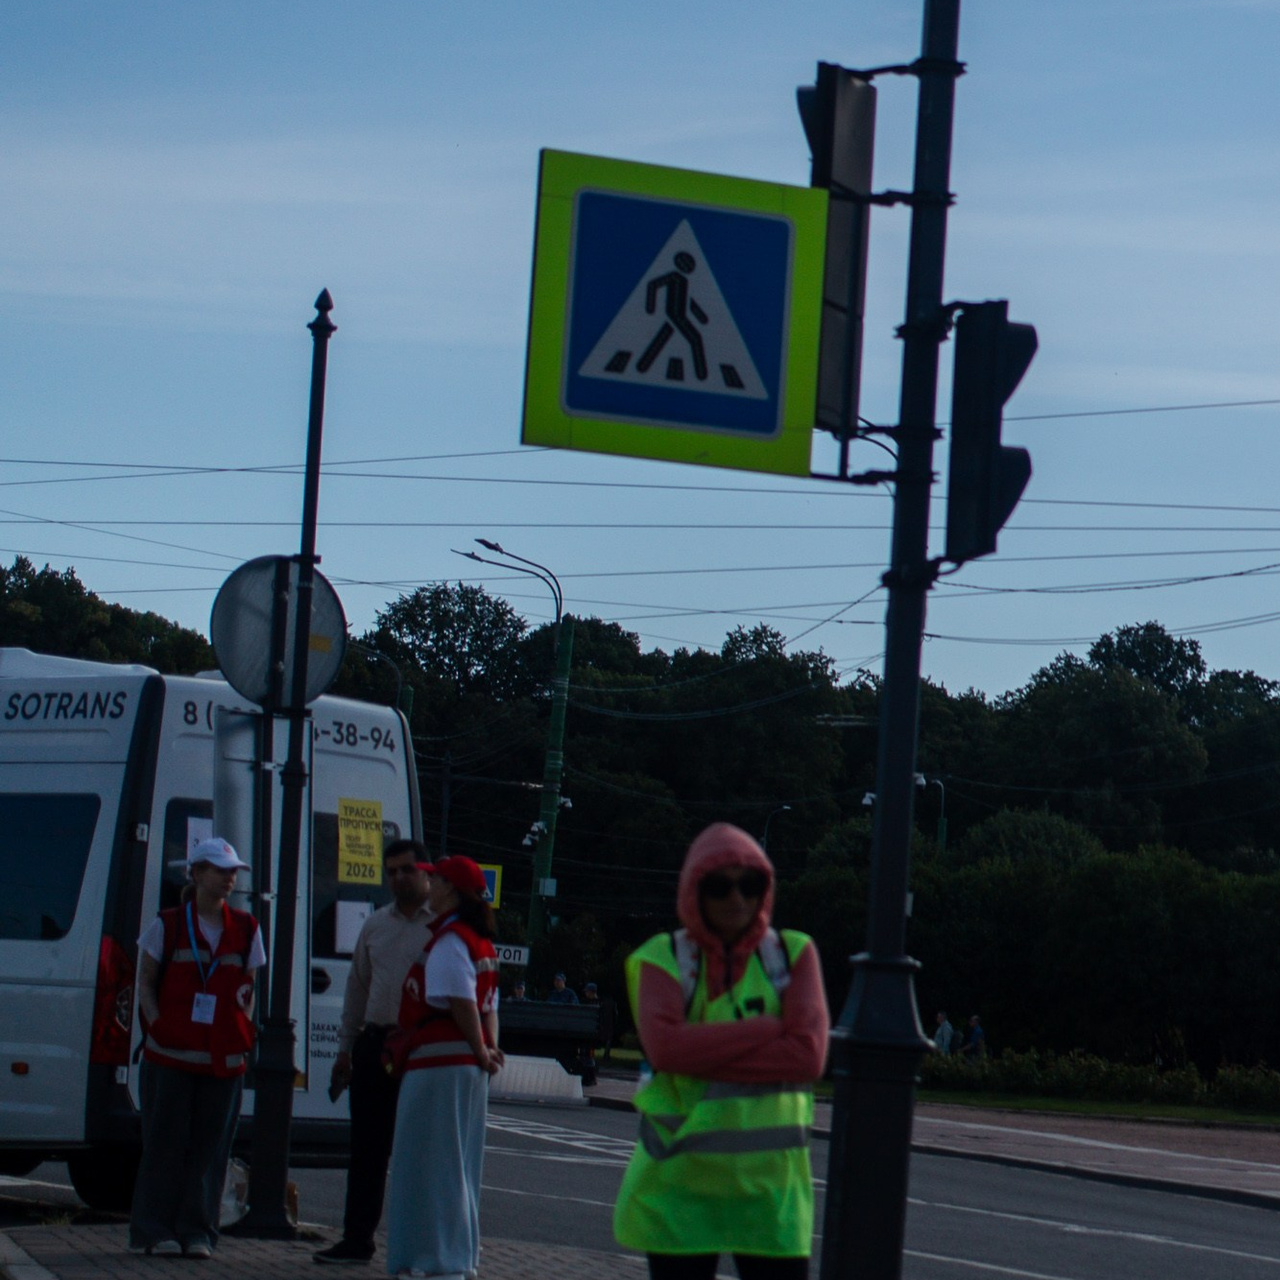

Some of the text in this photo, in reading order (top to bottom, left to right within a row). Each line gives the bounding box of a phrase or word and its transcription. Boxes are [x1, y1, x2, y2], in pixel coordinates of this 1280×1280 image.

[4, 691, 127, 720] SOTRANS
[184, 701, 198, 725] 8
[343, 805, 378, 819] ТРАССА
[340, 817, 381, 832] ПРОПУСК
[346, 862, 375, 878] 2026
